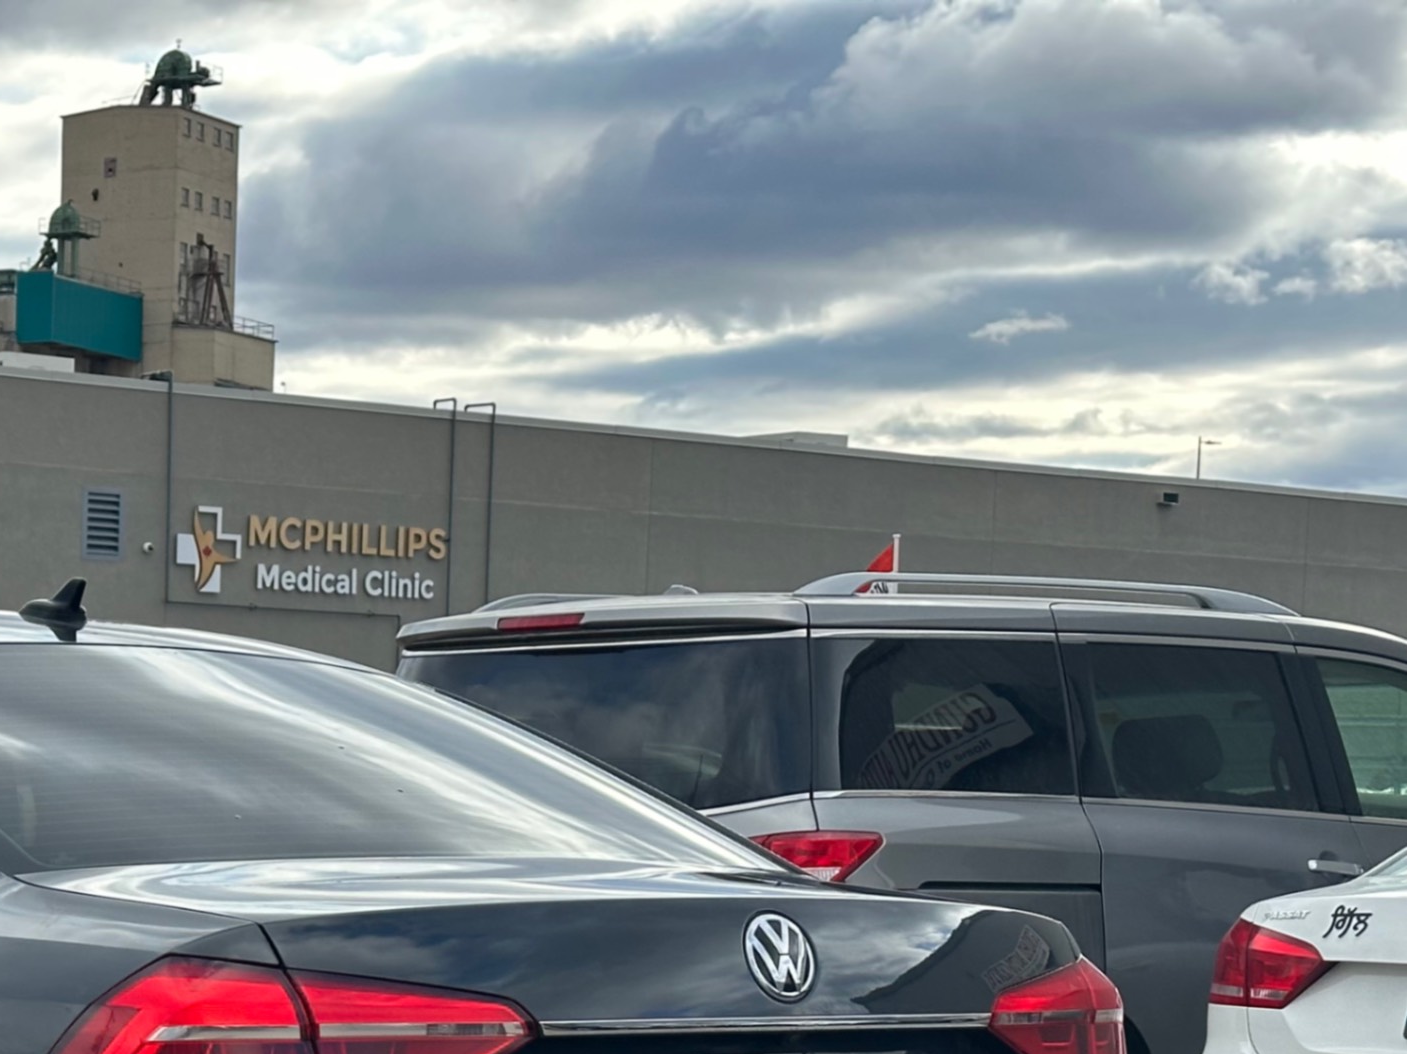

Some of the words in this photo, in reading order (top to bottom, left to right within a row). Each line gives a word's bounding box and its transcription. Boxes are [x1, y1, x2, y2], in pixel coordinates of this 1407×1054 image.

[249, 514, 447, 560] MCPHILLIPS
[256, 563, 358, 595] Medical
[364, 570, 435, 599] Clinic
